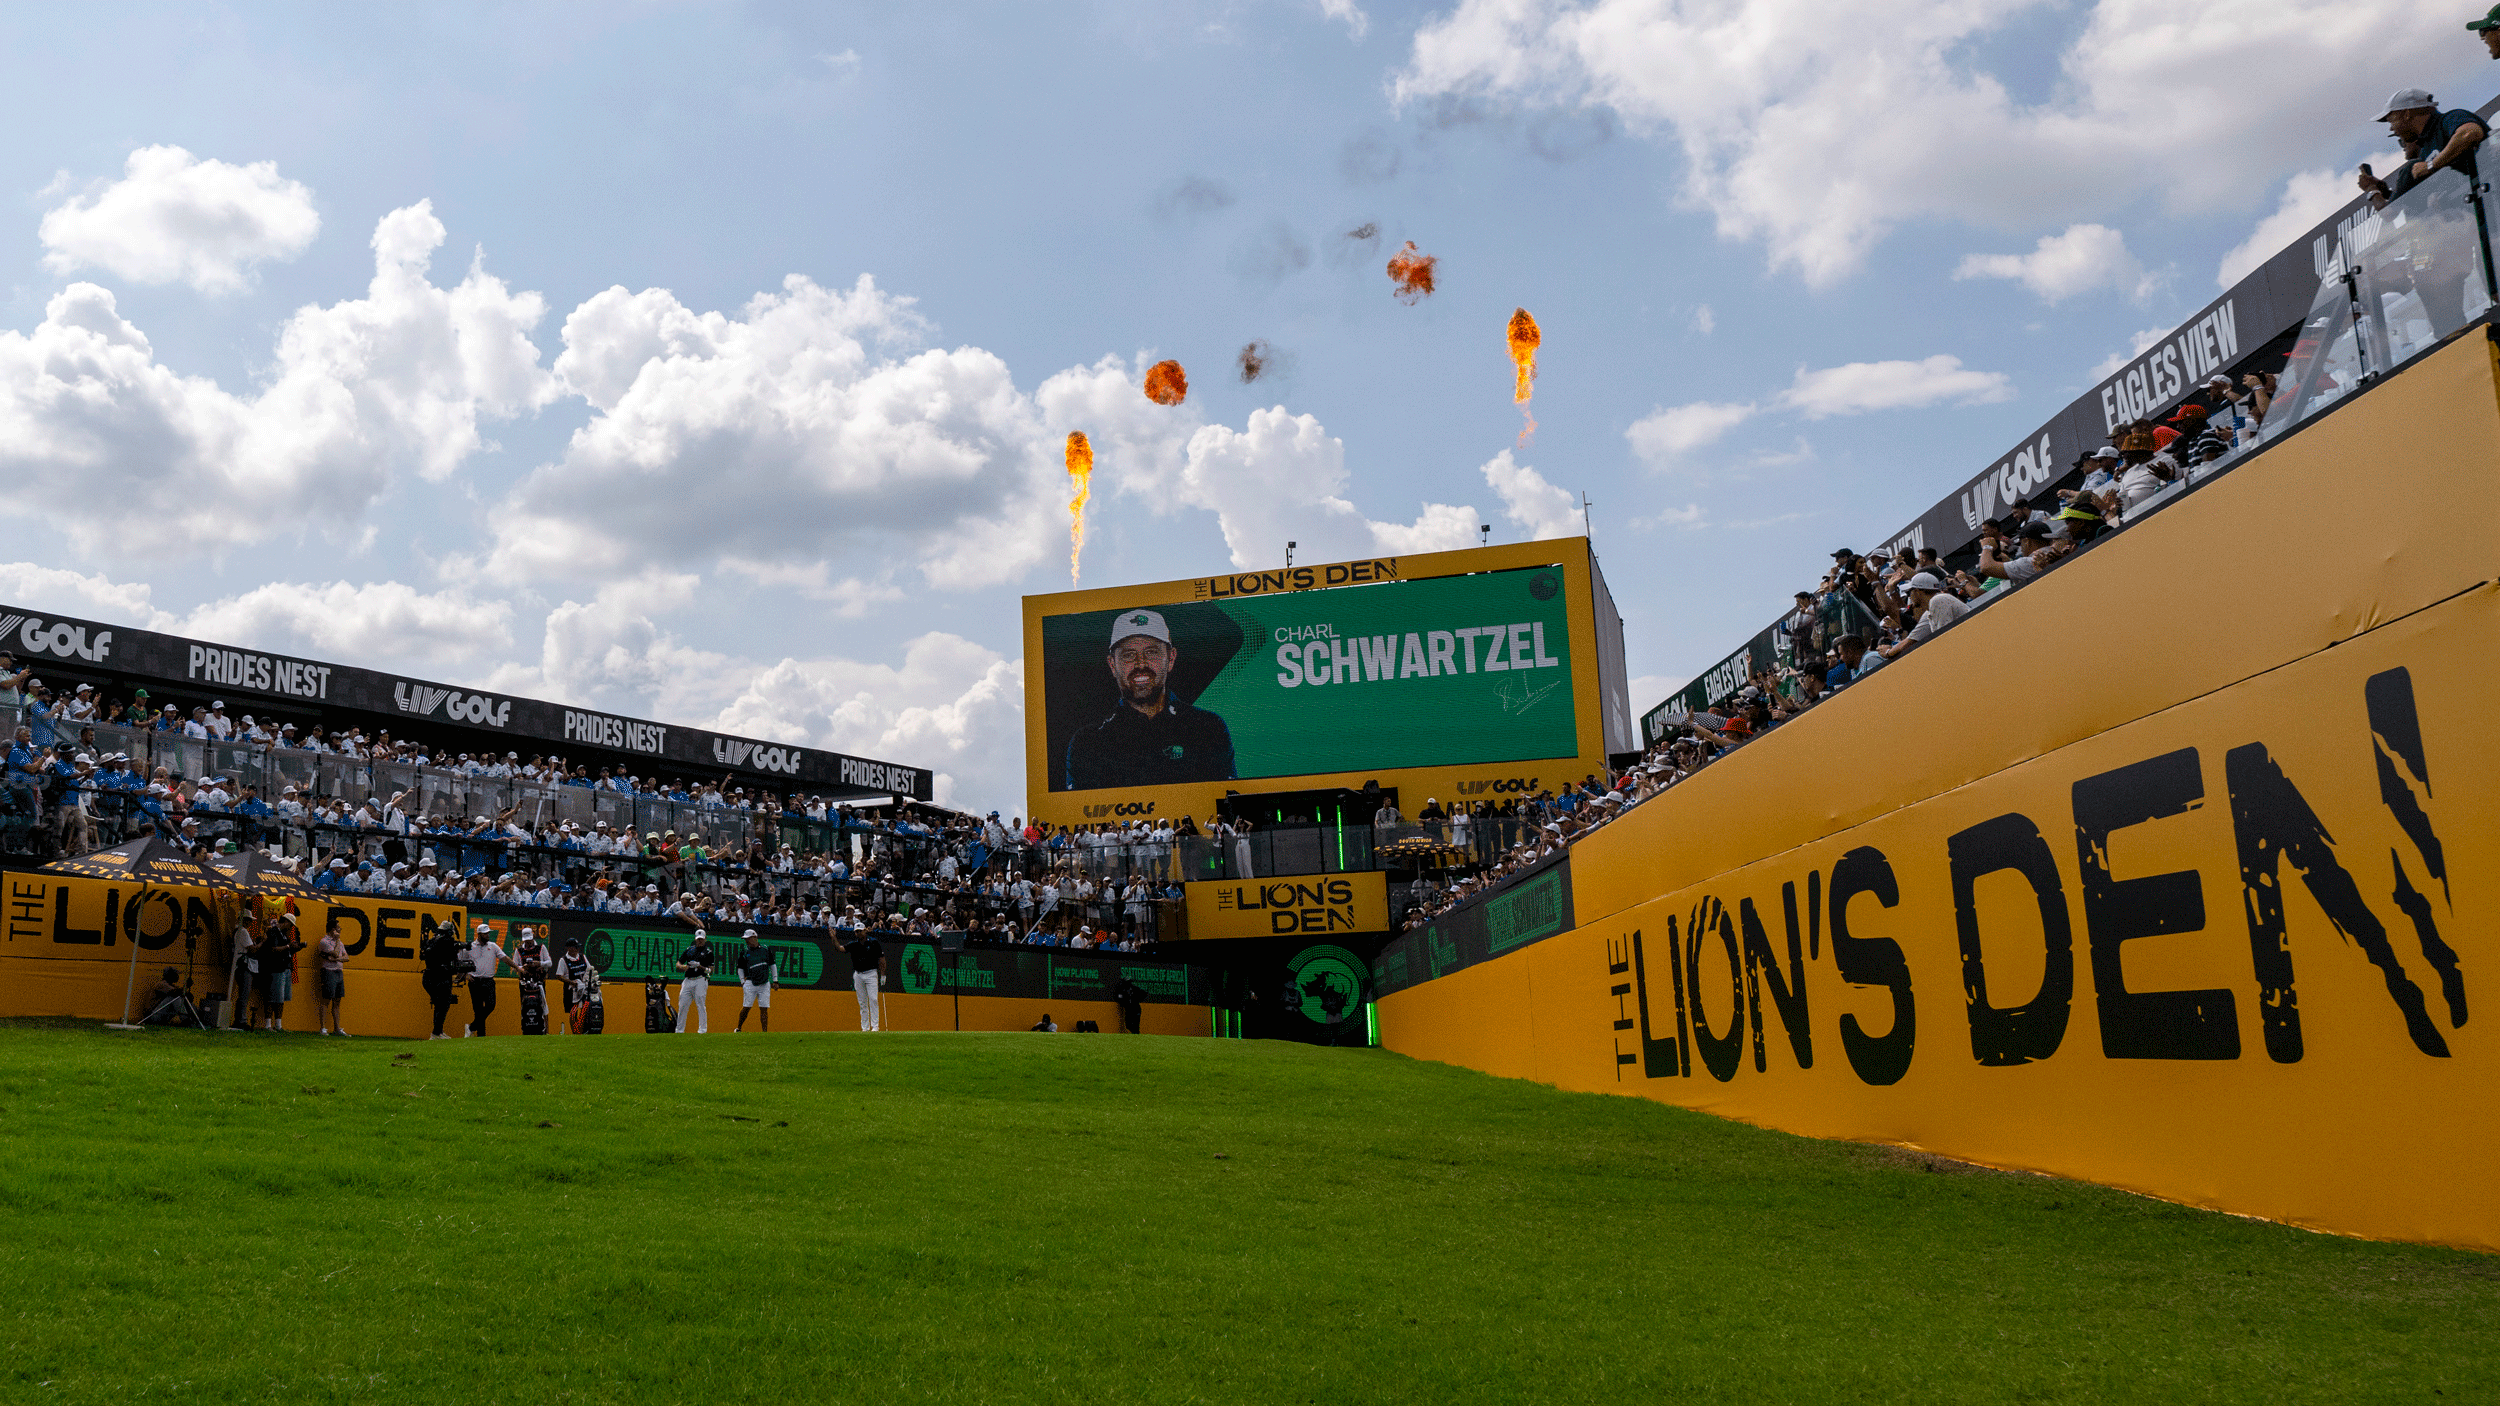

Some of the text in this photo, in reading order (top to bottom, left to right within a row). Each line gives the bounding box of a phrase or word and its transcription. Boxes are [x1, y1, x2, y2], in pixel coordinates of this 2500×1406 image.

[2101, 299, 2238, 435] EAGLES VIEW
[1961, 433, 2052, 531] LIV GOLF
[1195, 558, 1399, 600] THE LION'S DEN
[20, 617, 112, 663] GOLF
[1274, 622, 1341, 643] CHARL
[189, 645, 331, 699] PRIDES NEST
[1276, 621, 1558, 688] SCHWARTZEL
[394, 681, 511, 728] LIV GOLF
[1704, 661, 1734, 706] EAGLES
[564, 710, 666, 754] PRIDES NEST
[713, 738, 801, 774] LIV GOLF
[840, 758, 916, 795] PRIDES NEST
[1457, 777, 1538, 795] LIV GOLF
[1083, 802, 1155, 818] LIV GOLF
[1218, 877, 1353, 911] THE LION'S
[1607, 665, 2469, 1086] THE LION'S DEN
[9, 881, 46, 941] THE
[1271, 905, 1355, 934] DEN
[941, 967, 996, 988] SCHWARTZEL
[1054, 966, 1099, 980] NOW PLAYING
